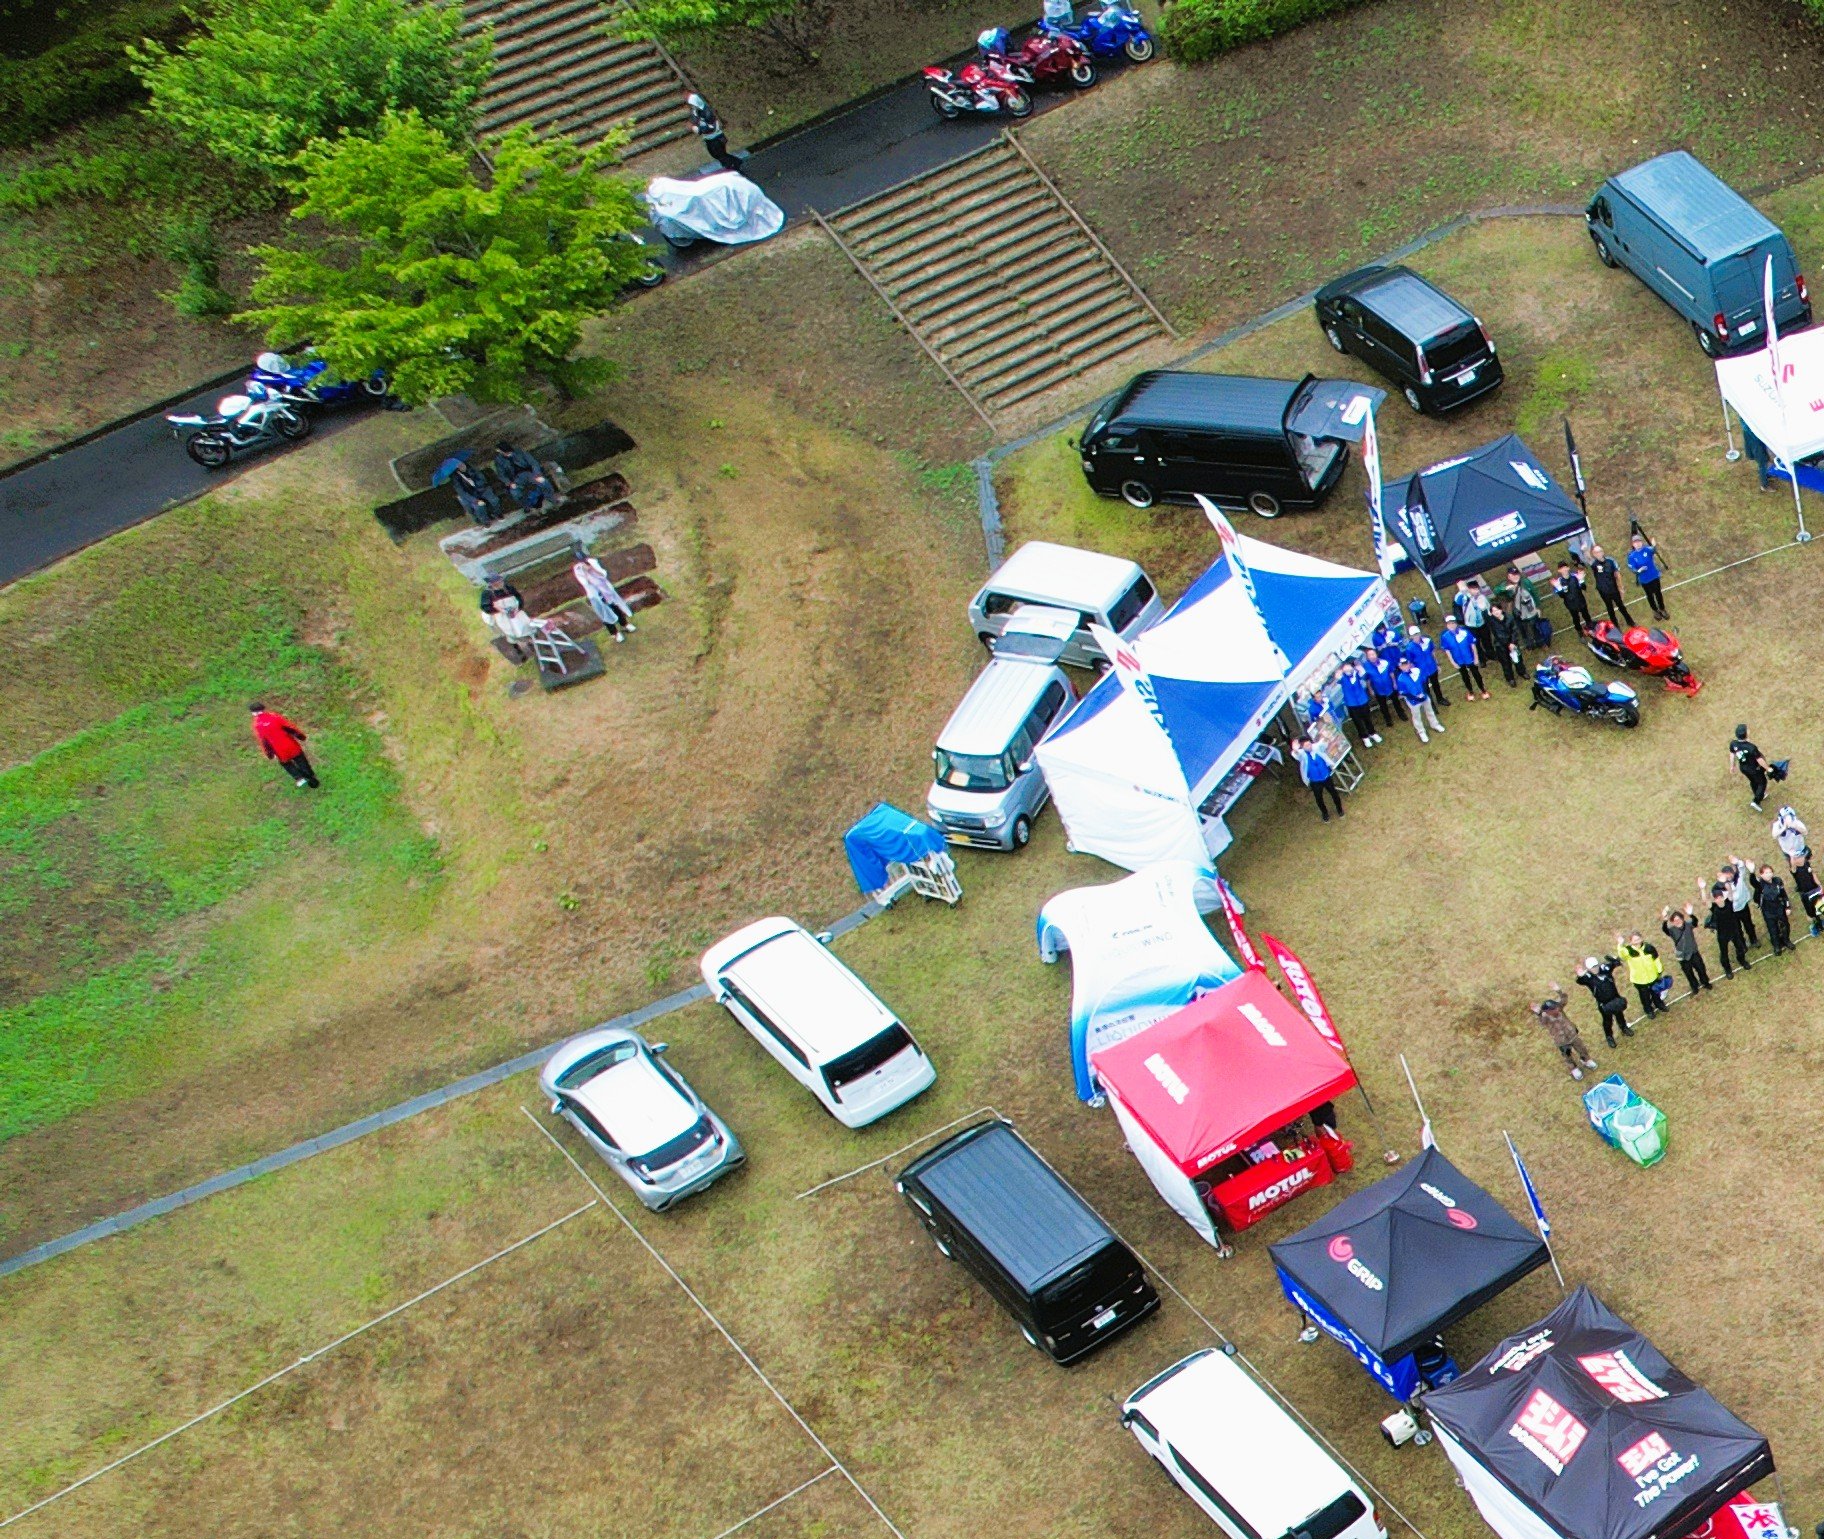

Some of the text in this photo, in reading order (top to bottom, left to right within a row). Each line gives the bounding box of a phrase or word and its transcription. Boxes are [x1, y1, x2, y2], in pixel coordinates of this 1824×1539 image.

[1197, 1143, 1238, 1169] MOTUL
[1249, 1167, 1316, 1210] MOTUL
[1420, 1182, 1456, 1208] GRIP
[1347, 1258, 1383, 1291] GRIP
[1518, 1388, 1588, 1465] ヨシムラ
[1633, 1454, 1700, 1508] The Power!
[1635, 1451, 1683, 1489] I've Got
